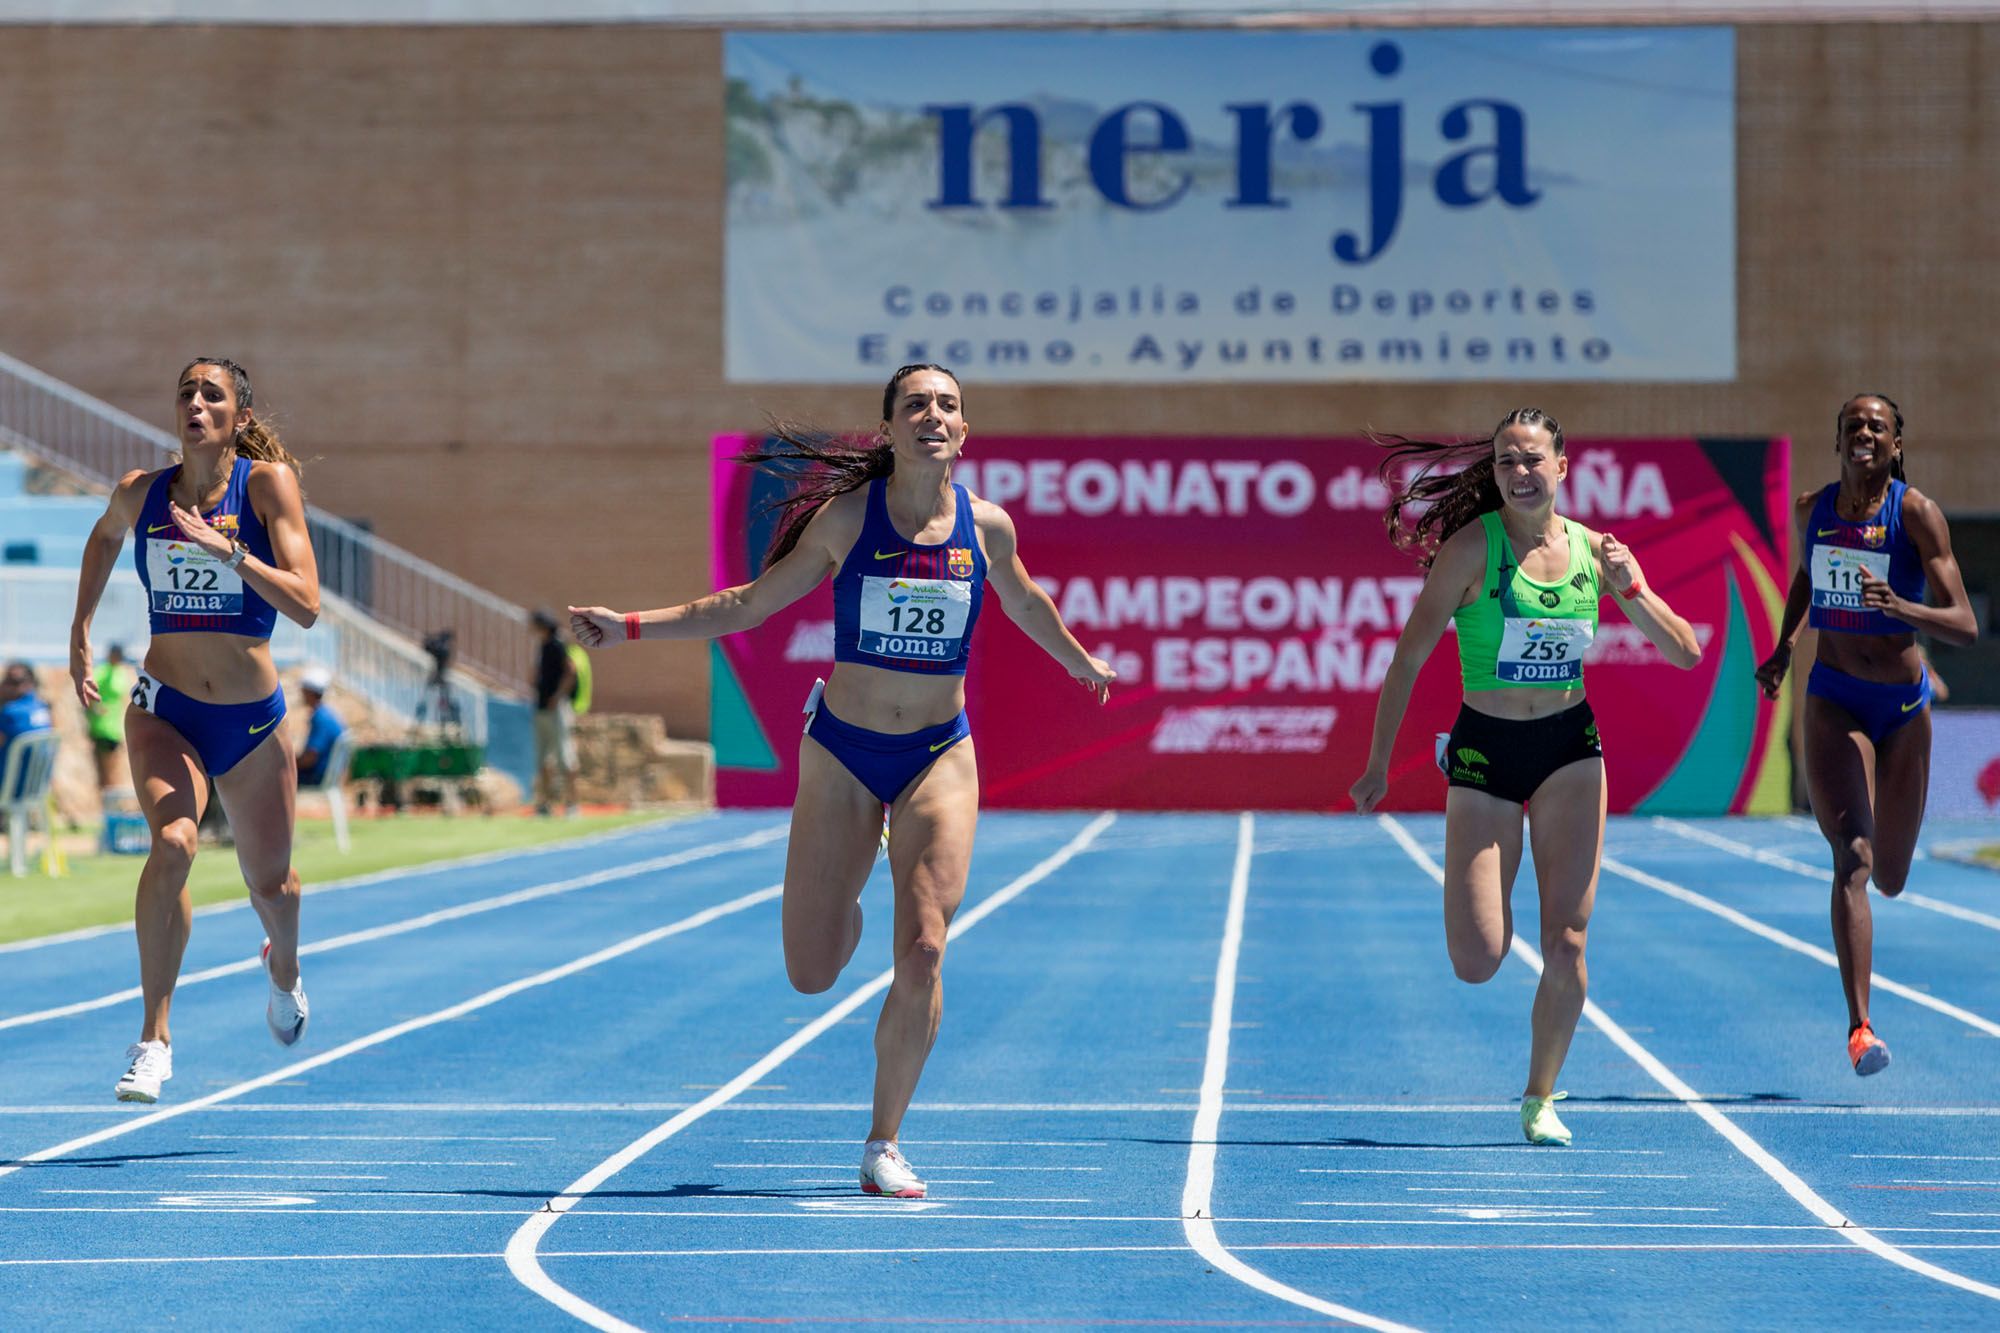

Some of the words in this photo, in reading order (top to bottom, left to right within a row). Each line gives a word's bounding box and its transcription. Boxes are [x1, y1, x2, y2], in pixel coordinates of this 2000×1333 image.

[922, 42, 1542, 266] nerja
[1234, 285, 1296, 316] de
[1332, 284, 1596, 320] Deportes
[857, 334, 1101, 365] Excmo.
[1127, 332, 1611, 368] Ayuntamiento
[168, 567, 218, 590] 122
[888, 606, 945, 634] 128
[1520, 641, 1569, 660] 259
